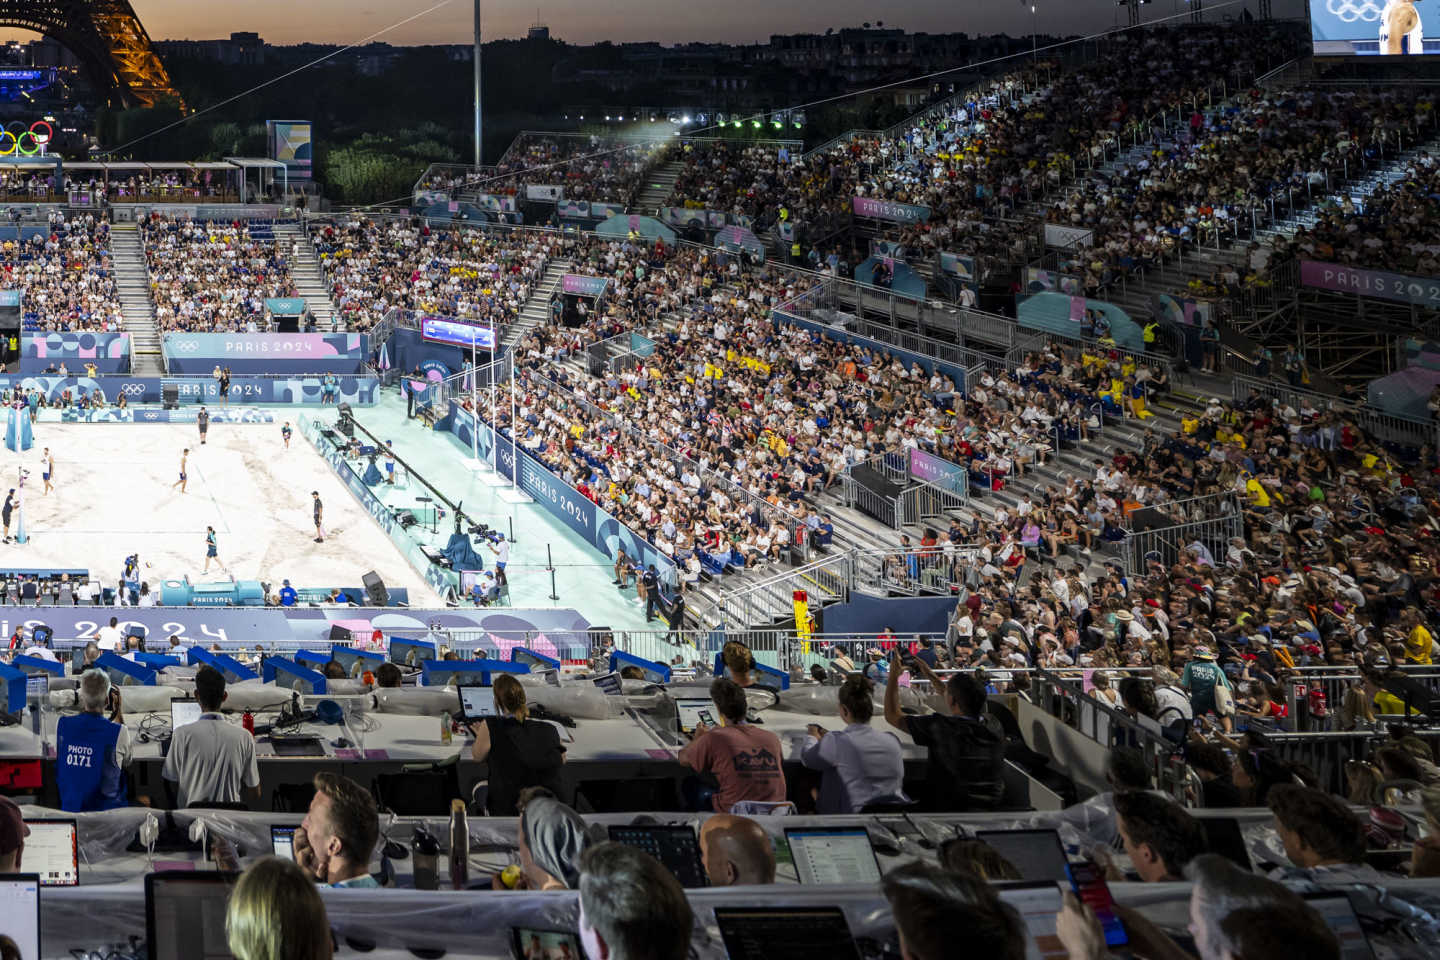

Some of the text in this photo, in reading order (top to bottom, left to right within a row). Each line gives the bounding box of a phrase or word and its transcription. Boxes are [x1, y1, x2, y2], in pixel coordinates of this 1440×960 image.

[863, 203, 891, 215] PARIS
[1325, 270, 1385, 291] PARIS
[225, 342, 312, 352] PARIS 2024
[177, 384, 217, 396] ARIS
[529, 472, 588, 528] PARIS 2024
[68, 744, 93, 755] PHOTO
[66, 753, 91, 768] 0171
